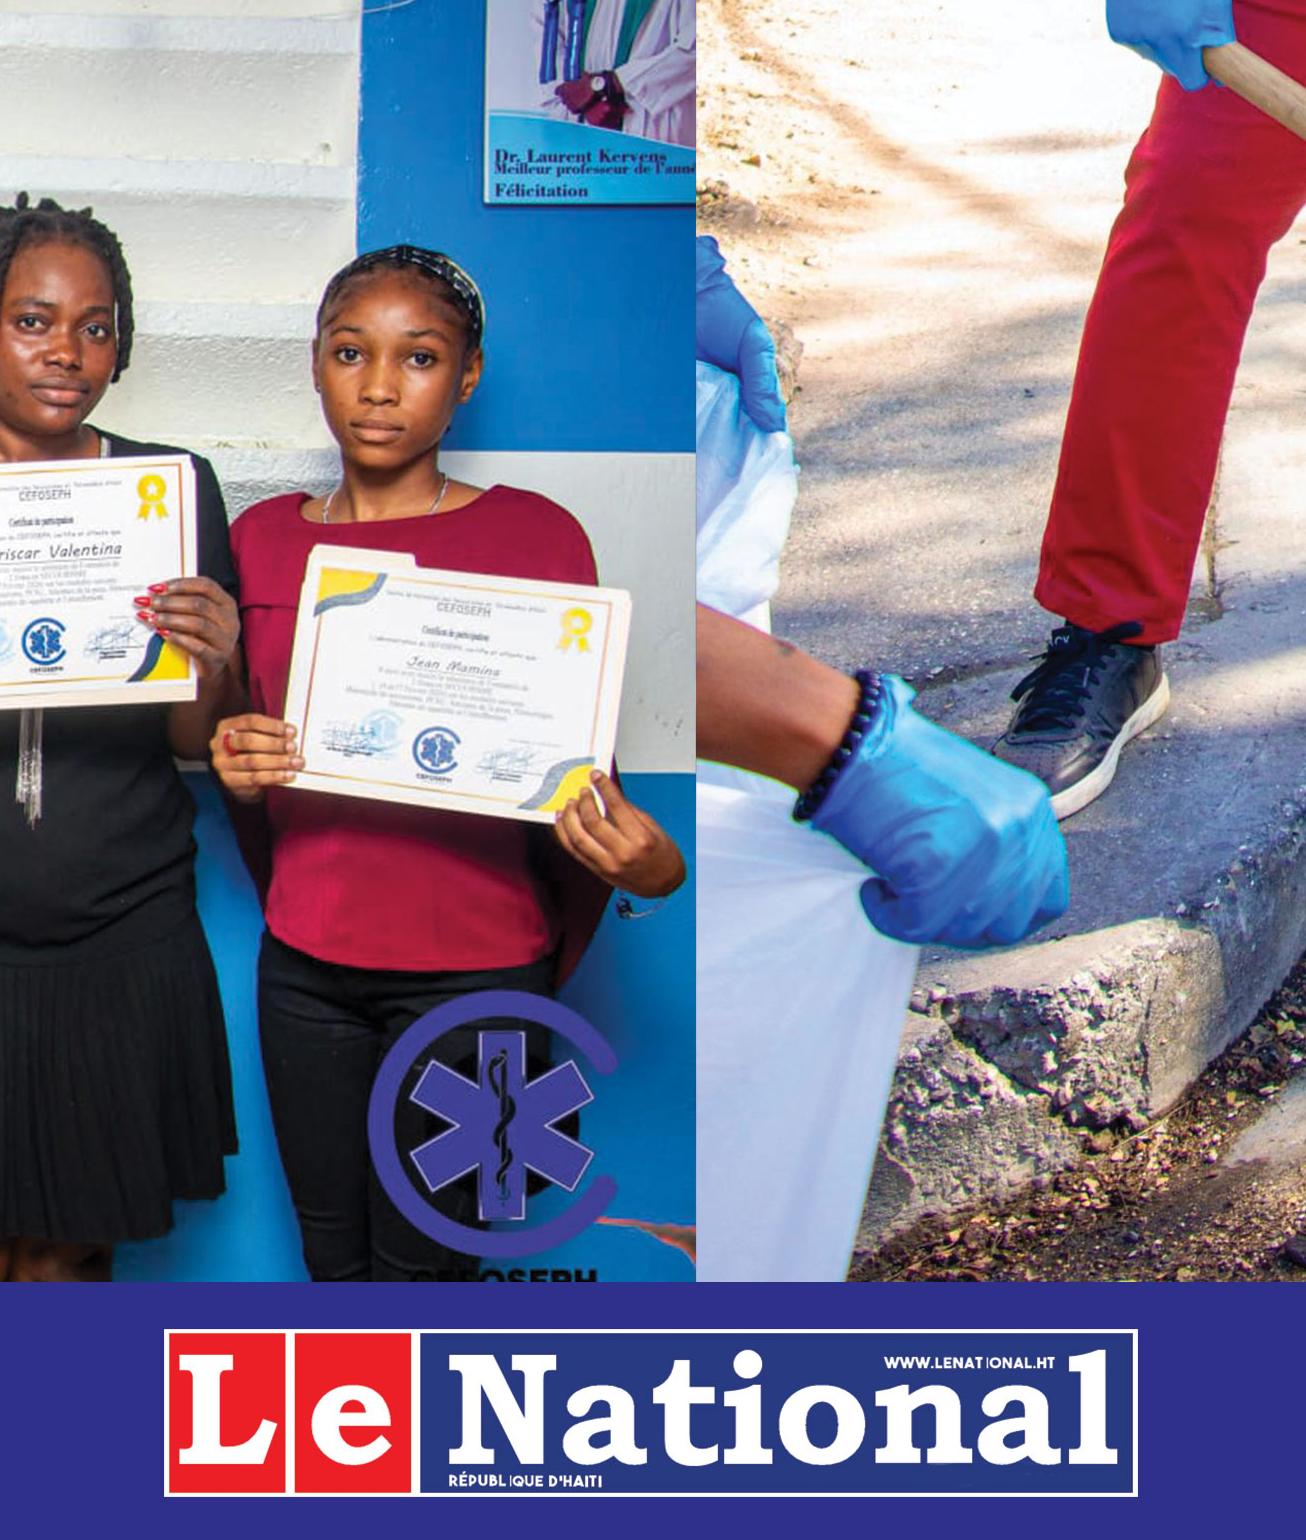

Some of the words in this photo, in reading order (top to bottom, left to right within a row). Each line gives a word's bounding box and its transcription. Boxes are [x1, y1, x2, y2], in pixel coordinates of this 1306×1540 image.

[495, 149, 521, 163] Dr.
[527, 149, 592, 163] Laurent
[598, 149, 667, 163] Kervens
[494, 162, 552, 174] Meilleur
[556, 162, 629, 177] professeur
[634, 163, 651, 174] de
[495, 183, 588, 197] Félicitation
[49, 543, 122, 559] Valentina
